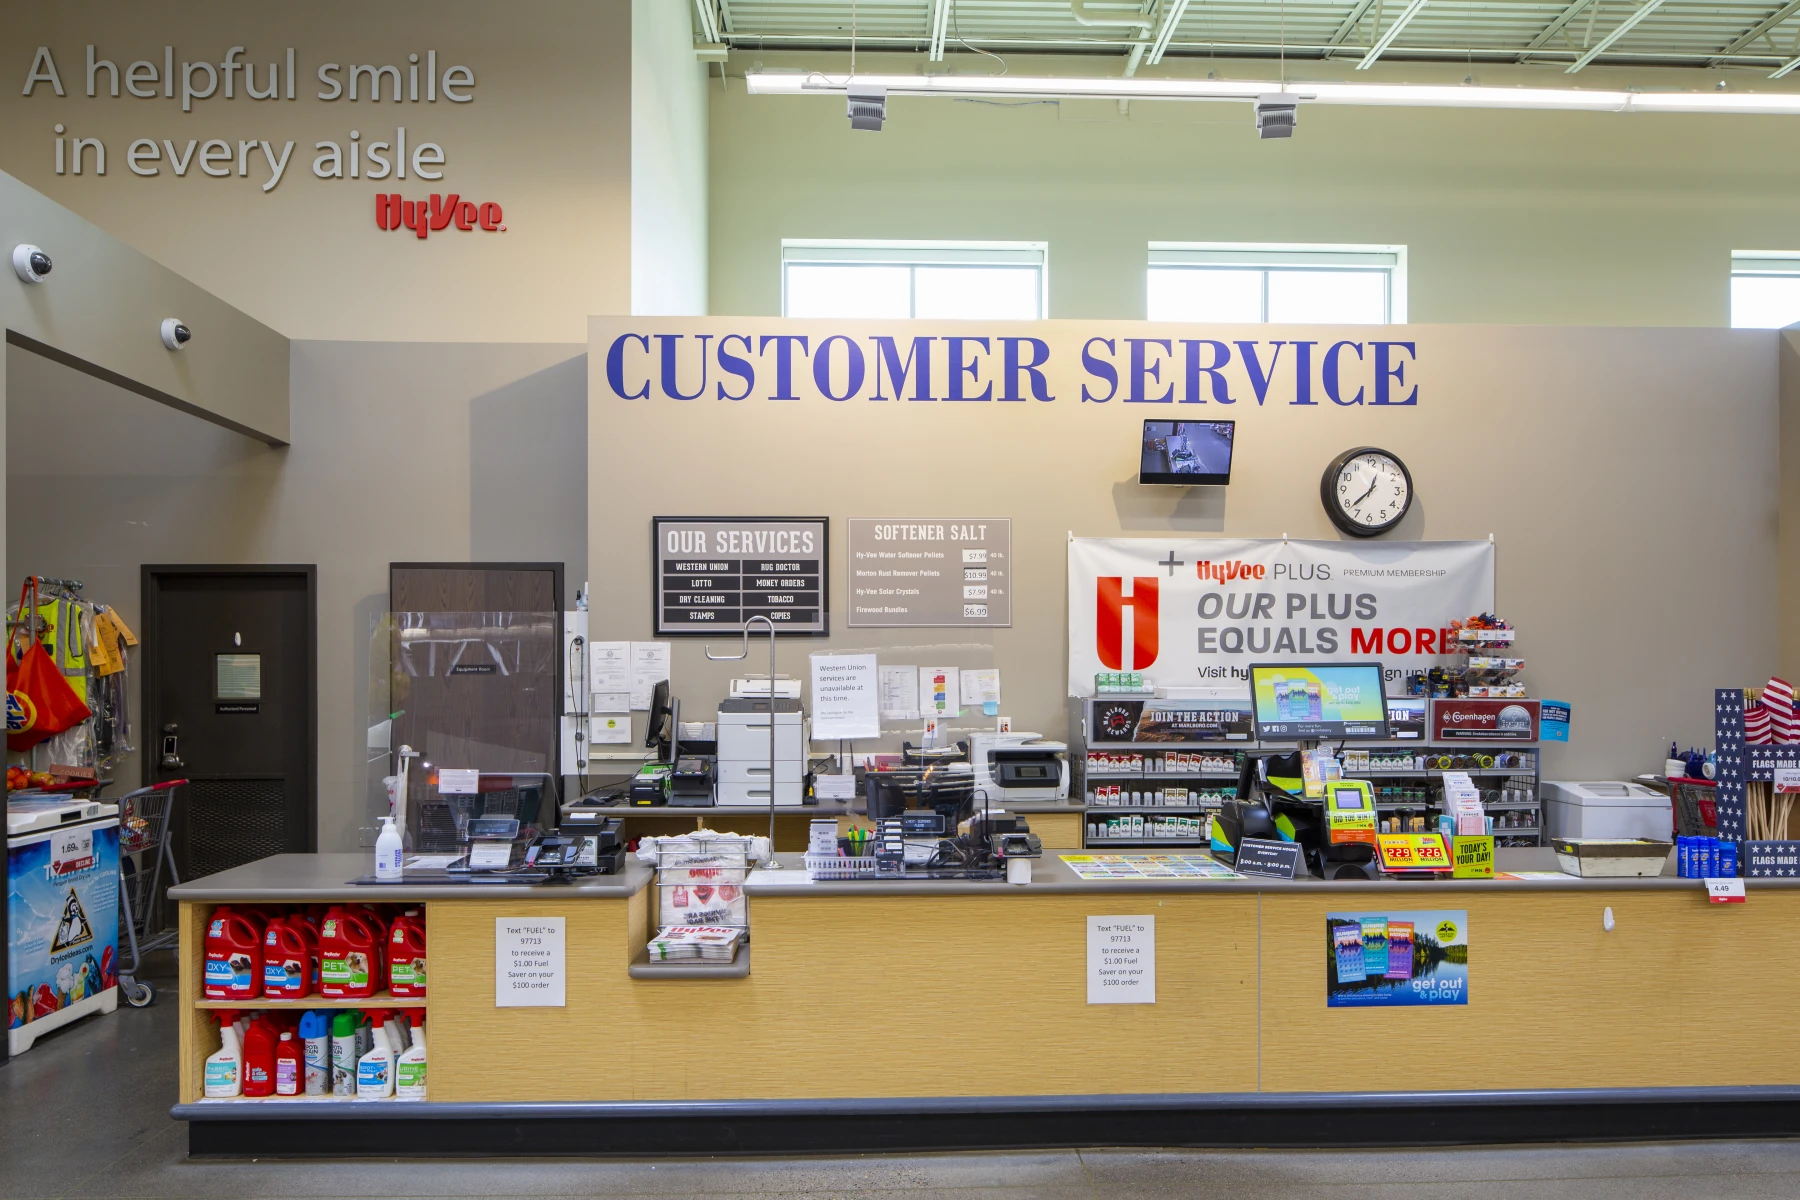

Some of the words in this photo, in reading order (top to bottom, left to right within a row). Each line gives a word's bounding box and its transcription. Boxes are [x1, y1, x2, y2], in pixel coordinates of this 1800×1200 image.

[22, 46, 66, 97] A
[86, 44, 296, 111] helpful
[317, 49, 476, 102] smile
[54, 124, 106, 175] in
[127, 137, 295, 192] every
[313, 127, 446, 180] aisle
[606, 333, 1055, 402] CUSTOMER
[1081, 337, 1418, 406] SERVICE
[1354, 463, 1360, 472] 11
[1368, 458, 1376, 468] 12
[1382, 464, 1385, 472] 1
[1344, 472, 1352, 481] 10
[1390, 473, 1396, 482] 2
[1340, 485, 1347, 494] 9
[1394, 487, 1400, 496] 3
[1344, 499, 1350, 508] 8
[1389, 500, 1396, 508] 4
[1354, 509, 1360, 518] 7
[1366, 513, 1372, 522] 6
[1380, 510, 1386, 518] 5
[875, 524, 944, 540] SOFTENER
[951, 525, 987, 540] SALT
[667, 530, 707, 553] OUR
[716, 530, 814, 553] SERVICES
[856, 552, 877, 560] Hy-Vee
[968, 552, 986, 560] $7.99
[676, 563, 707, 571] WESTERN
[710, 563, 729, 571] UNION
[761, 563, 774, 571] RUG
[775, 563, 800, 571] DOCTOR
[1274, 564, 1331, 581] PLUS
[1344, 568, 1384, 577] PREMIUM
[1386, 568, 1446, 577] MEMBERSHIP
[856, 588, 877, 596] Hy-Vee
[896, 588, 920, 596] Crystals
[968, 588, 986, 596] $7.99
[680, 596, 692, 604] DRY
[694, 596, 724, 604] CLEANING
[768, 596, 794, 604] TOBACCO
[1196, 592, 1276, 620] OUR
[1287, 592, 1378, 620] PLUS
[690, 612, 714, 620] STAMPS
[770, 612, 791, 620] COPIES
[965, 608, 987, 616] $6.99
[1198, 626, 1338, 654] EQUALS
[1198, 667, 1227, 678] Visit
[820, 684, 856, 692] unavailable
[1150, 712, 1174, 722] JOIN
[1177, 712, 1197, 722] THE
[1200, 712, 1239, 722] ACTION
[1452, 712, 1496, 724] Copenhagen
[1752, 760, 1775, 768] FLAGS
[1776, 760, 1797, 768] MADE
[60, 770, 92, 778] COOKIES
[62, 843, 75, 854] 1.69
[1460, 842, 1487, 854] TODAY'S
[1456, 855, 1474, 864] YOUR
[1476, 852, 1490, 863] DAY!
[1752, 856, 1776, 865] FLAGS
[1776, 856, 1796, 864] MADE
[76, 858, 91, 868] DECLINE
[50, 944, 94, 965] DryIceIdeas.com
[208, 962, 227, 972] OXY
[324, 962, 344, 970] PET
[514, 960, 532, 968] $1.00
[1098, 968, 1116, 976] Saver
[1412, 978, 1436, 993] get
[1440, 978, 1462, 989] out
[1429, 988, 1460, 1002] play
